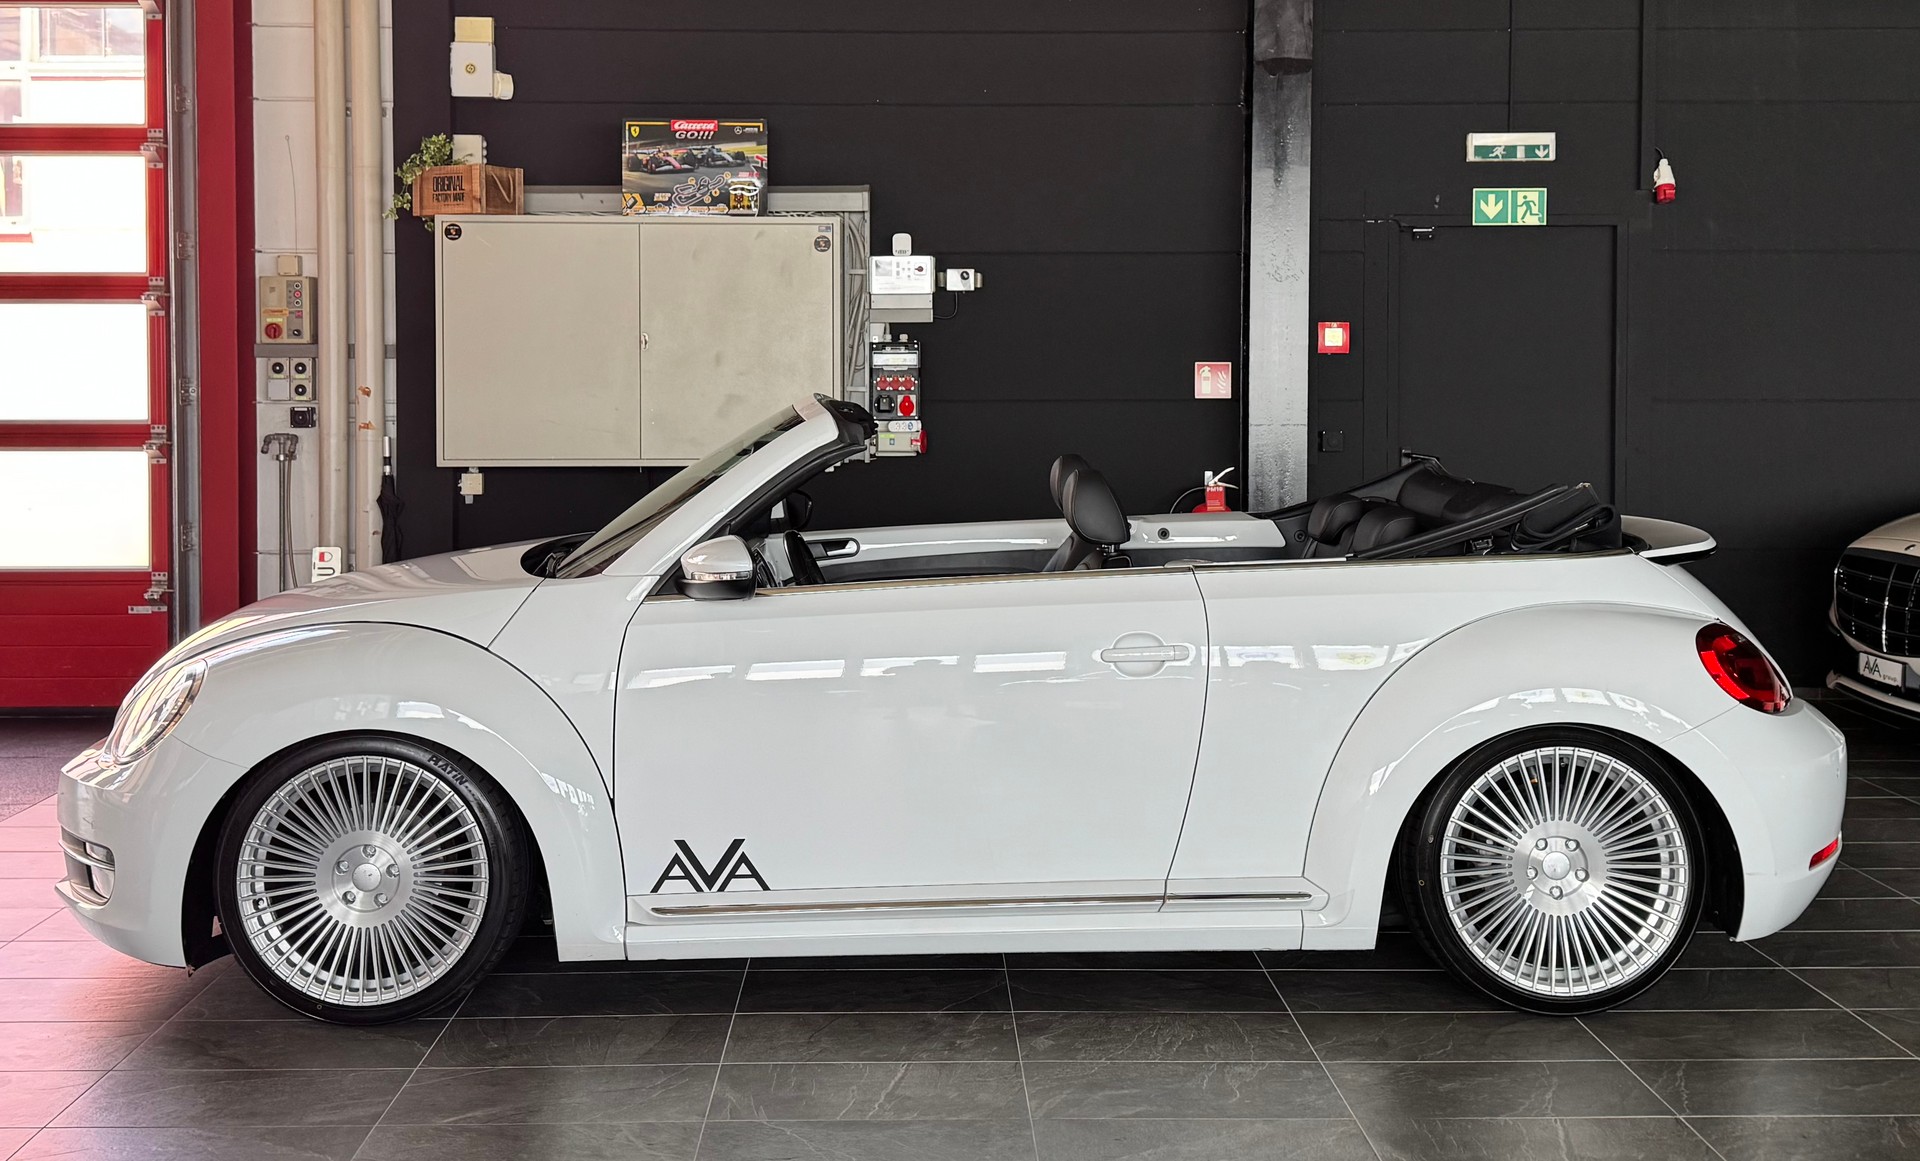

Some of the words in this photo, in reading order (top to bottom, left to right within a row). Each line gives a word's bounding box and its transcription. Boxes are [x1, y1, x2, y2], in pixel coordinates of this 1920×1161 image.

[673, 121, 716, 130] Carrera
[675, 130, 715, 140] GO!!!
[432, 175, 465, 192] ORIGINAL
[1863, 655, 1882, 678] AVA
[650, 838, 772, 893] AVA
